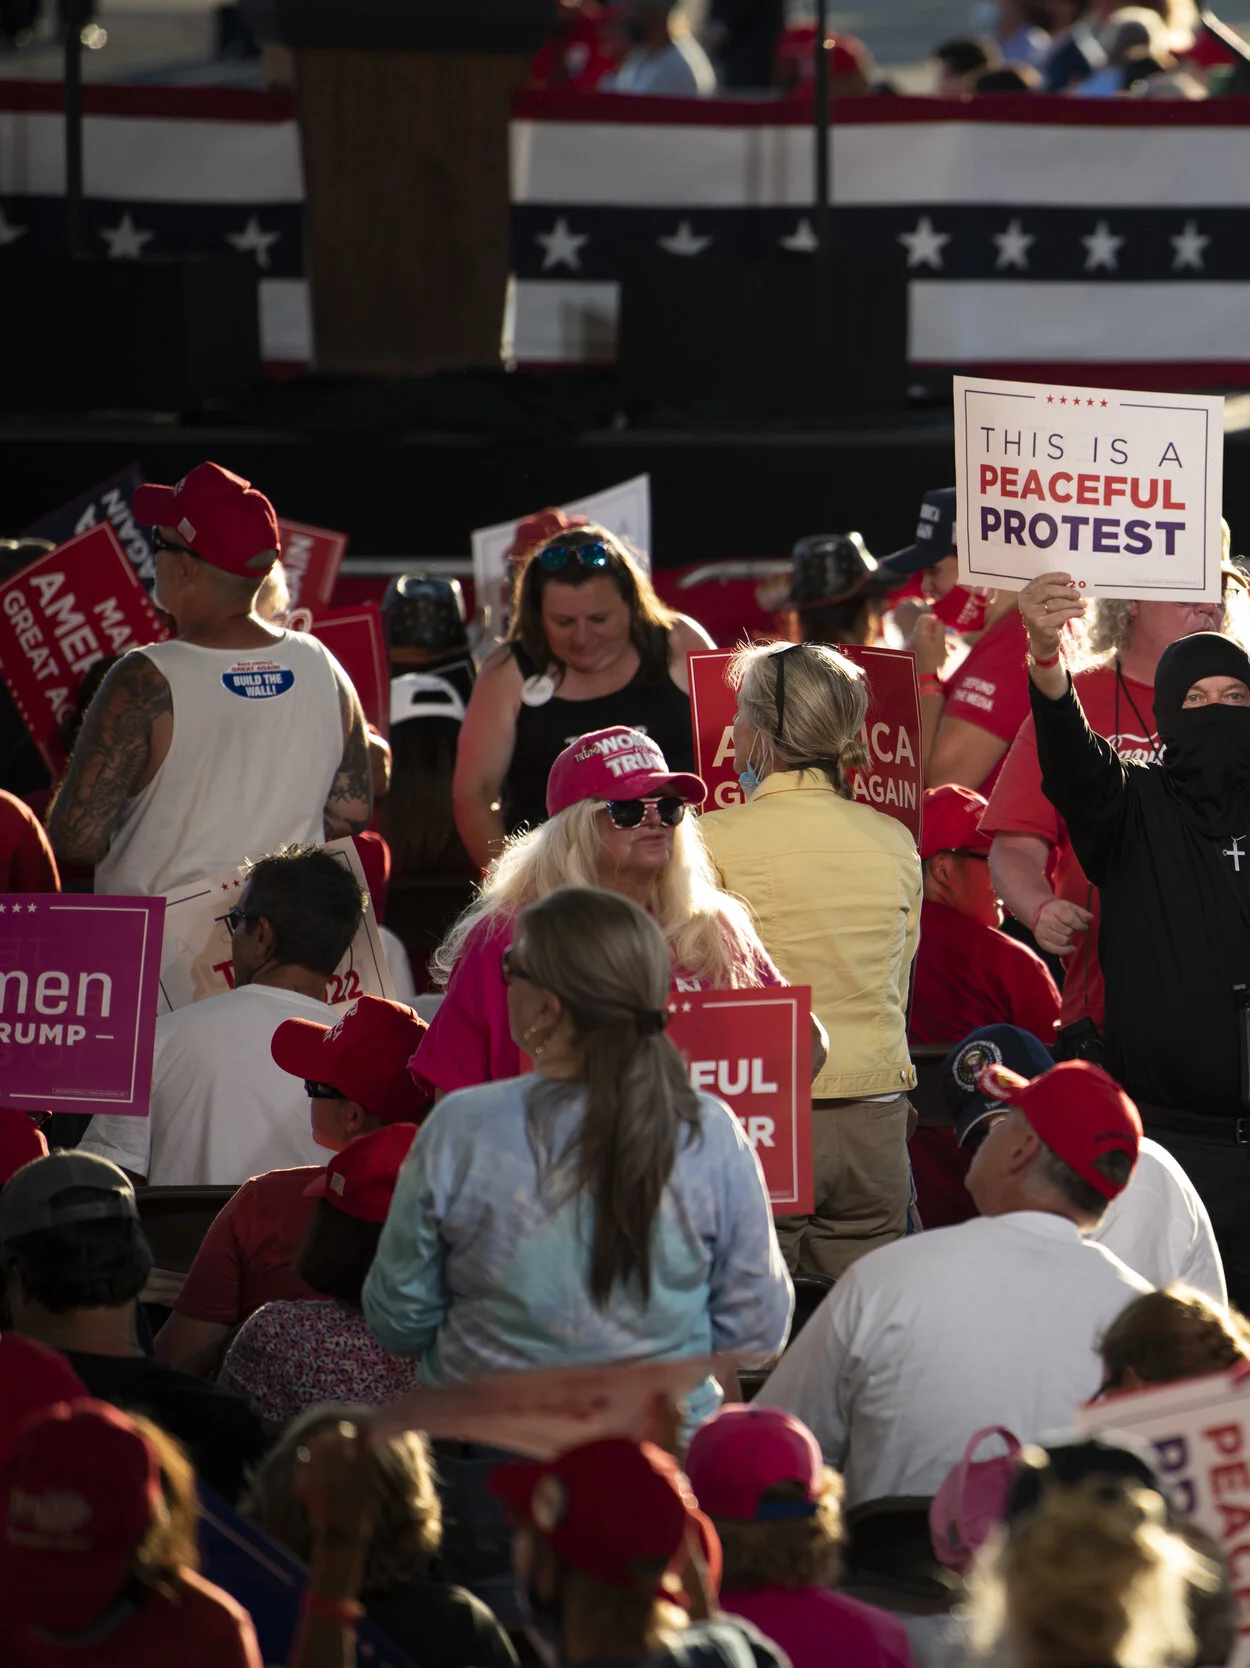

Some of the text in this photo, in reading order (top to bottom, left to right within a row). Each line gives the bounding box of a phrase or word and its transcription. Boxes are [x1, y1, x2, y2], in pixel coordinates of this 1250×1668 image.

[981, 426, 1183, 469] THIS IS A
[980, 463, 1186, 511] PEACEFUL
[980, 506, 1186, 556] PROTEST
[1068, 580, 1087, 589] 20
[4, 589, 60, 680] GREAT
[233, 673, 283, 687] BUILD THE
[245, 685, 277, 697] WALL!
[853, 773, 917, 811] AGAIN
[689, 1057, 779, 1096] FUL
